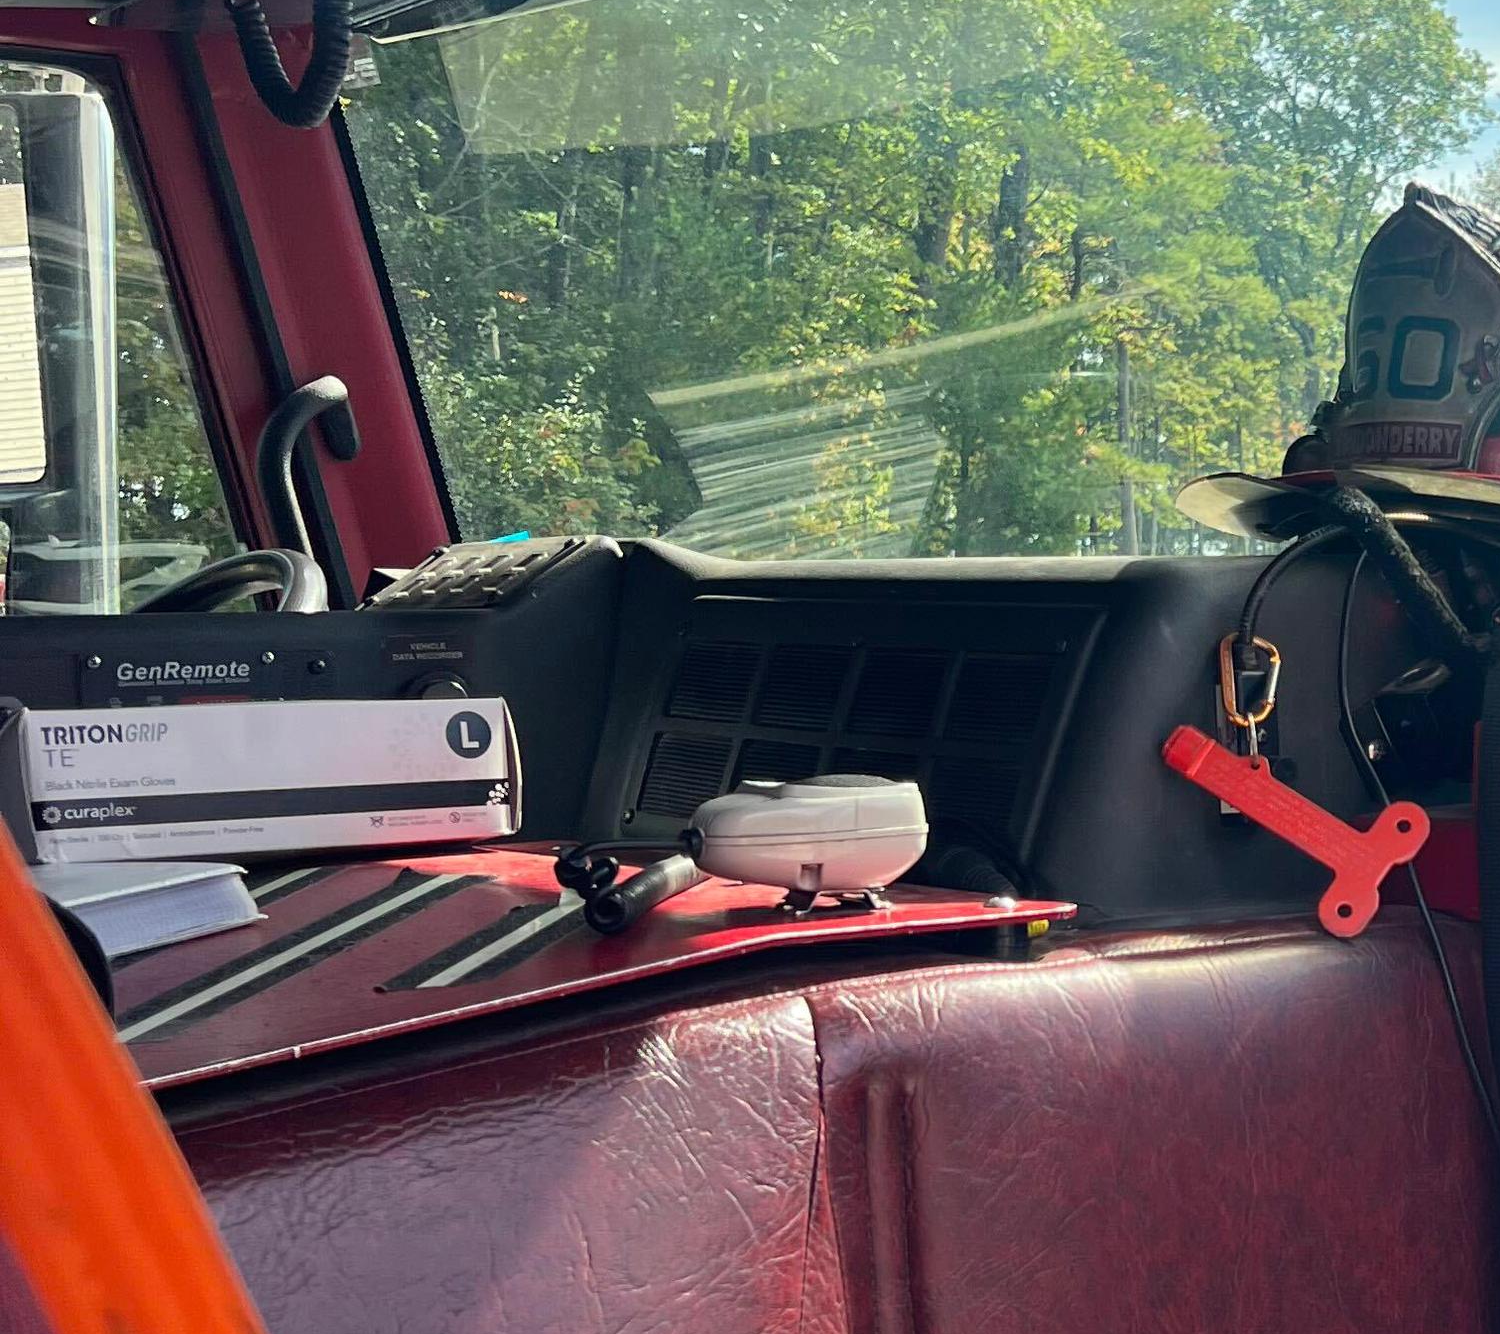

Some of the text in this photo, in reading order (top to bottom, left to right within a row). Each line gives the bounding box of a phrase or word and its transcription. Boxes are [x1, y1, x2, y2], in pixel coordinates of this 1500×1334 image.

[392, 652, 415, 661] DATA
[116, 660, 251, 681] GenRemote
[459, 720, 481, 749] L
[44, 776, 176, 792] Black Nitrile Exam Gloves
[64, 801, 135, 822] curaplex
